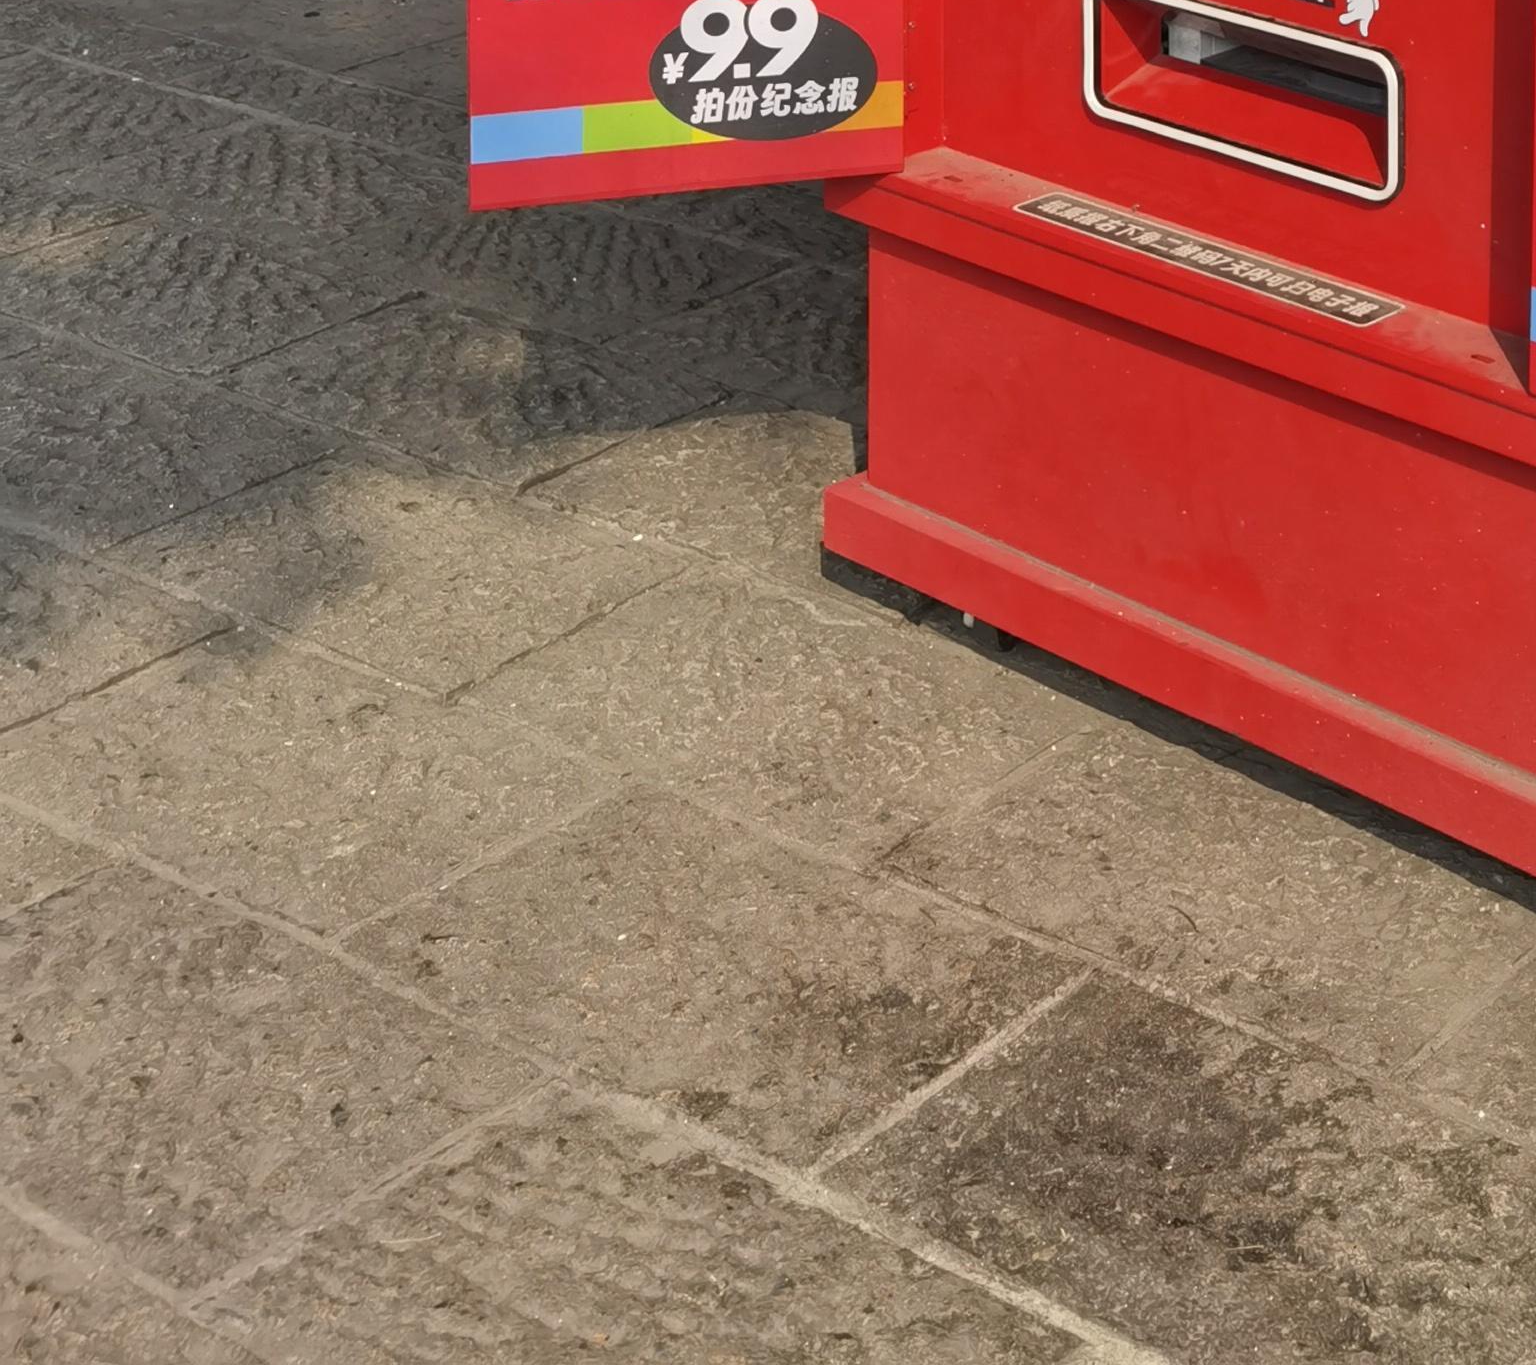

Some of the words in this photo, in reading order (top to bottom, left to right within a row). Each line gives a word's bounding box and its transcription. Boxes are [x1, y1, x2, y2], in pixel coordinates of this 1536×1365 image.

[690, 77, 860, 125] 拍份纪念报
